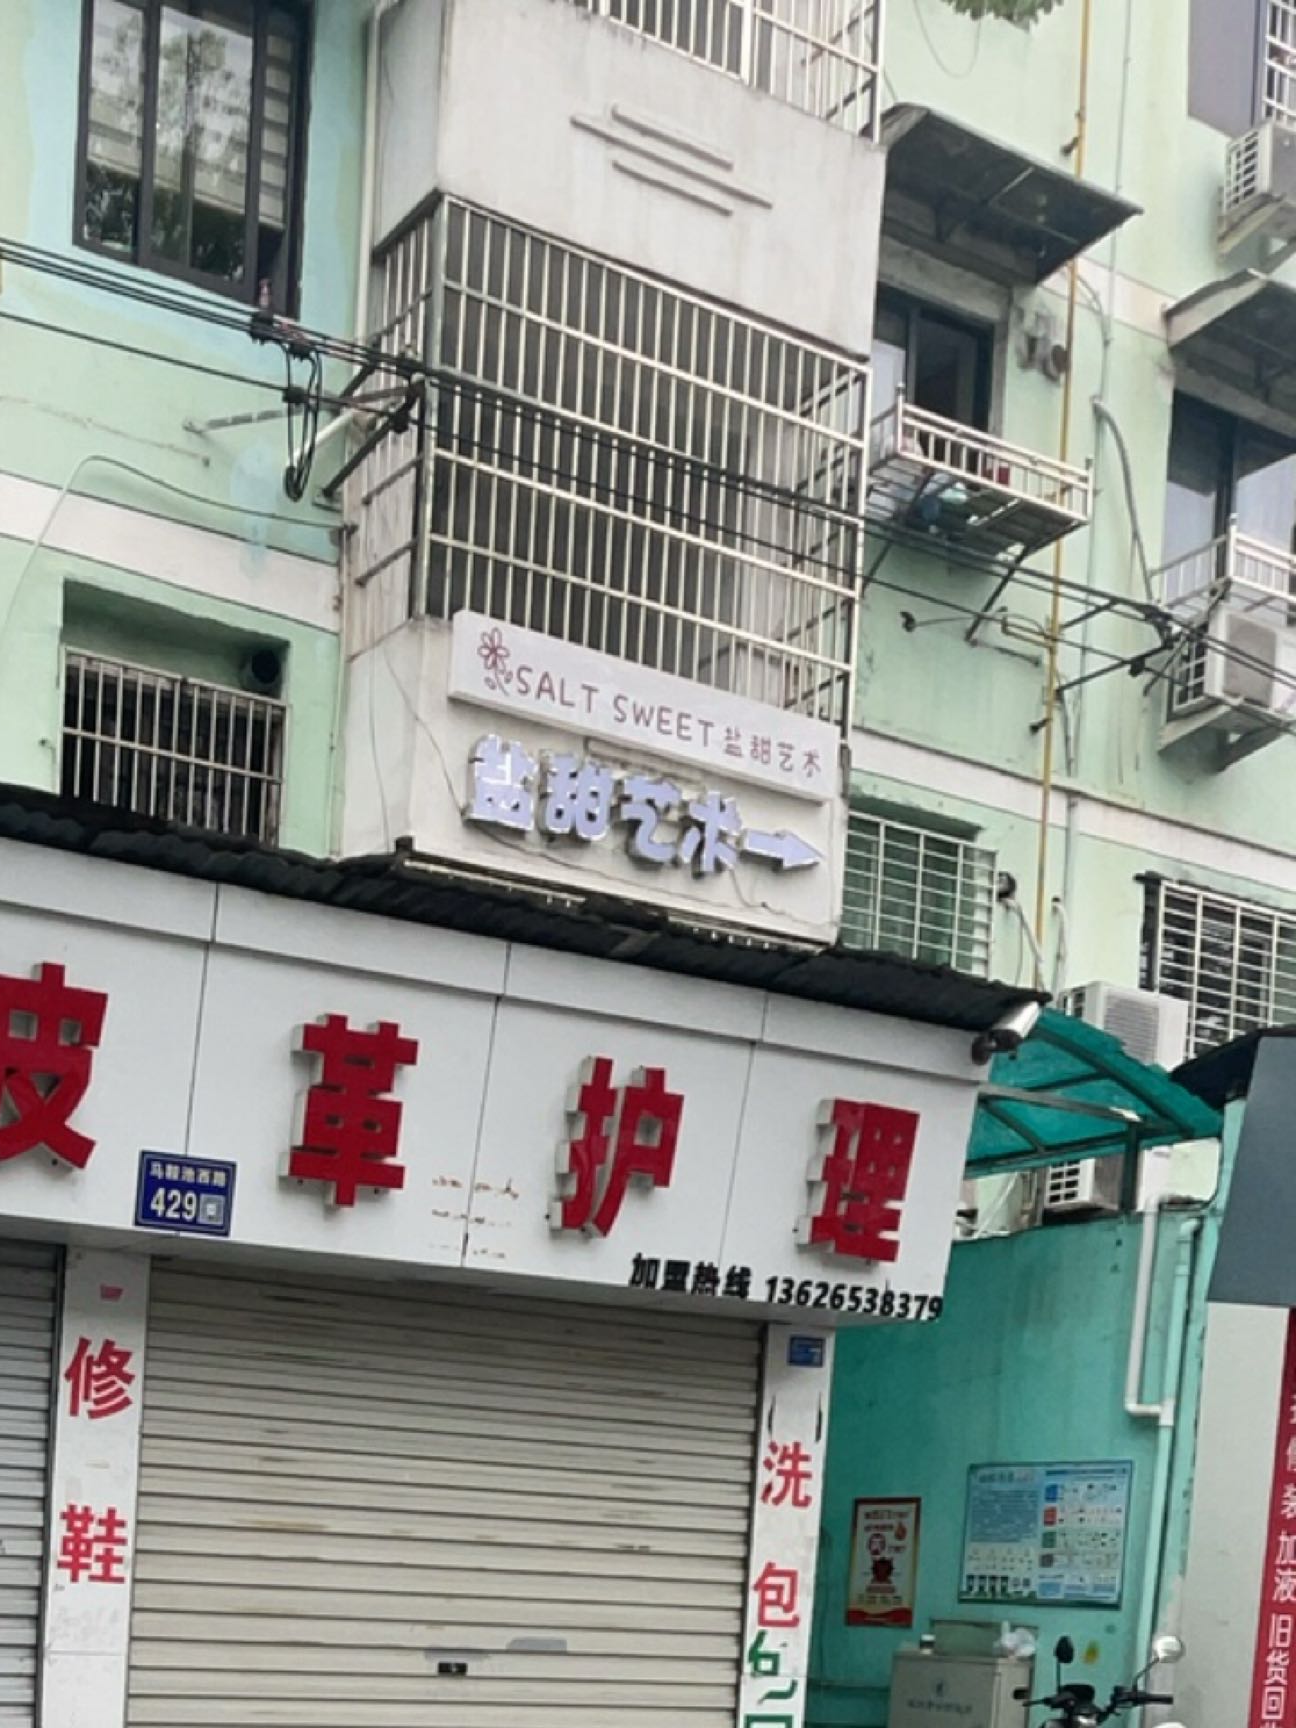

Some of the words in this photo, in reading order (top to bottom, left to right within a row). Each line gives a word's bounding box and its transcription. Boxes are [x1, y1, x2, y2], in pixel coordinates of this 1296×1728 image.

[515, 664, 600, 715] SALT
[613, 694, 715, 749] SWEET
[724, 726, 822, 779] 盐甜艺术
[469, 733, 744, 878] 盐甜艺术
[150, 1187, 197, 1222] 429
[629, 1253, 752, 1300] 加盟热线
[765, 1275, 944, 1321] 13626538379
[57, 1336, 136, 1585] 修鞋
[753, 1440, 813, 1629] 洗包
